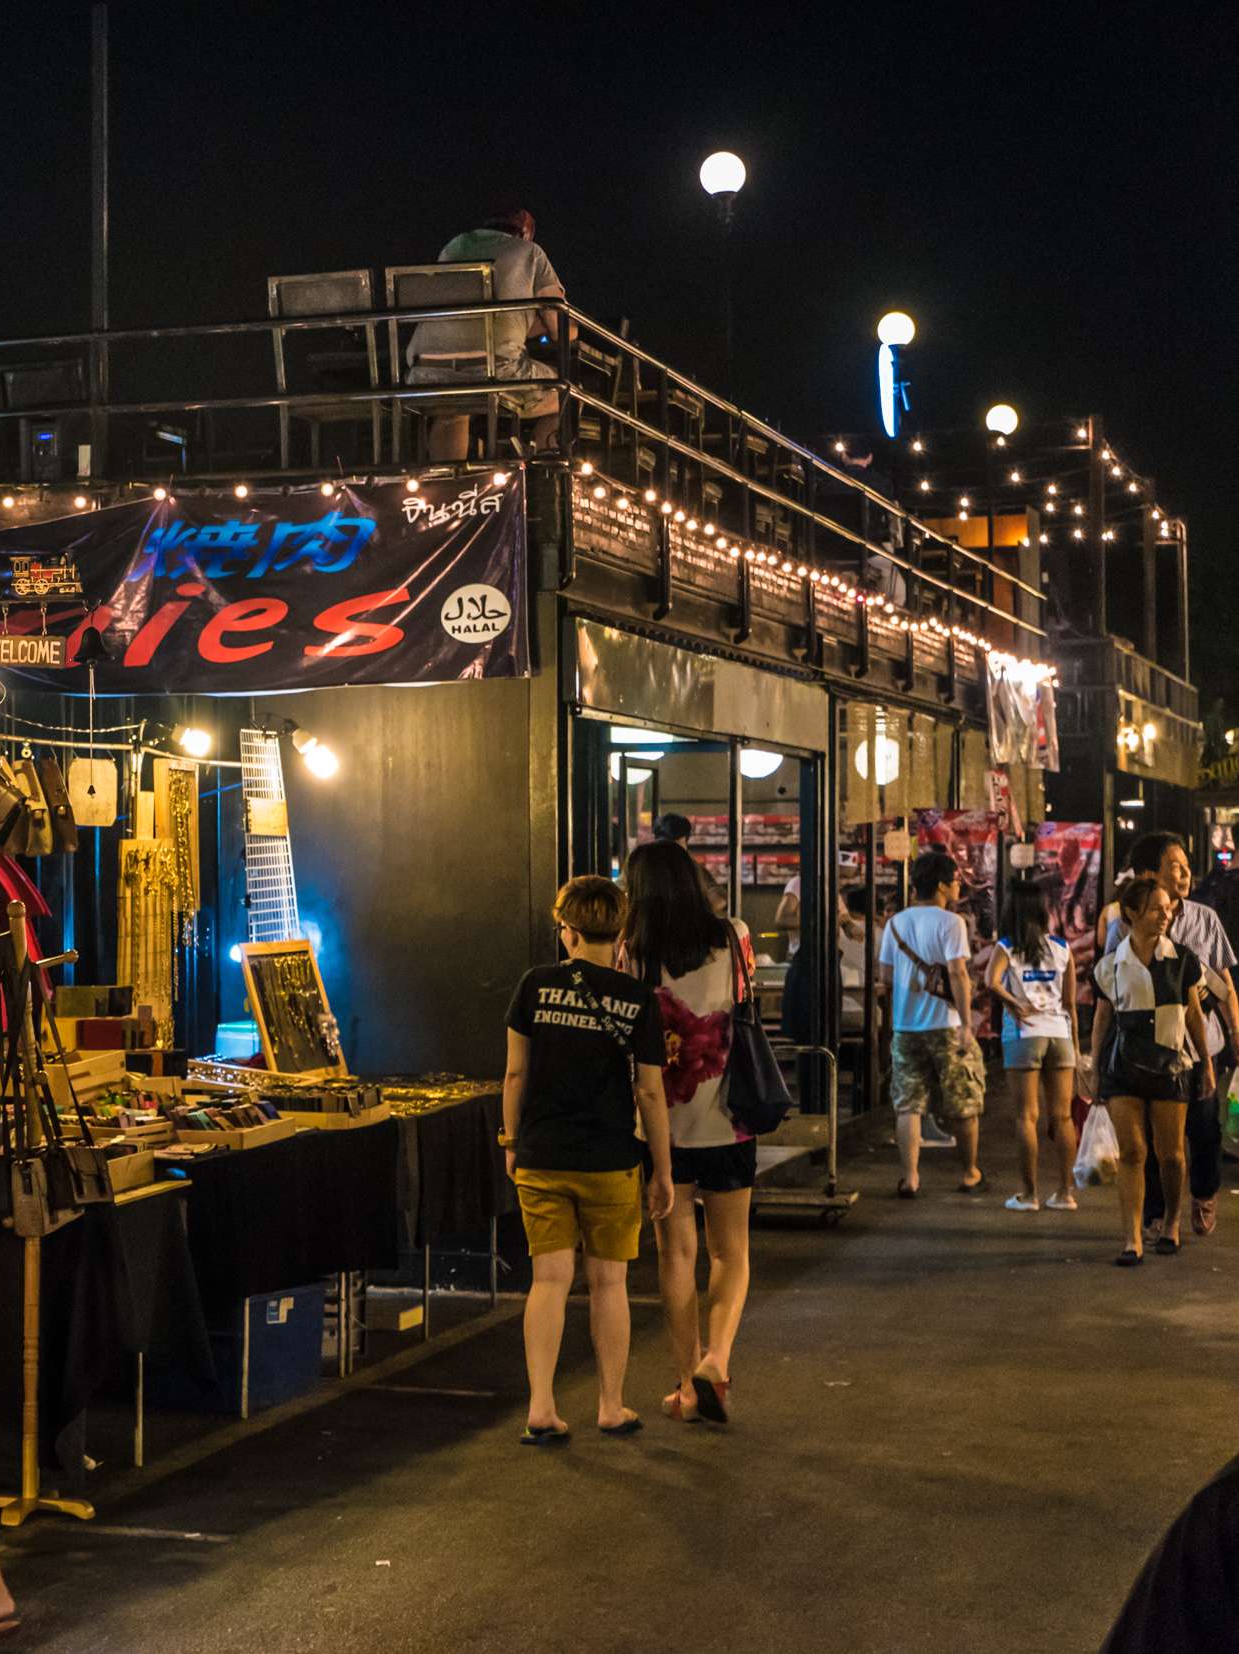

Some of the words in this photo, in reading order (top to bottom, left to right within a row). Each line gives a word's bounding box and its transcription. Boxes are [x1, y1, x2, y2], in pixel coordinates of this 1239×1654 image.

[444, 595, 508, 621] حلال
[451, 623, 500, 644] HALAL
[538, 987, 641, 1019] THAAND
[533, 1010, 634, 1035] ENGINEEG
